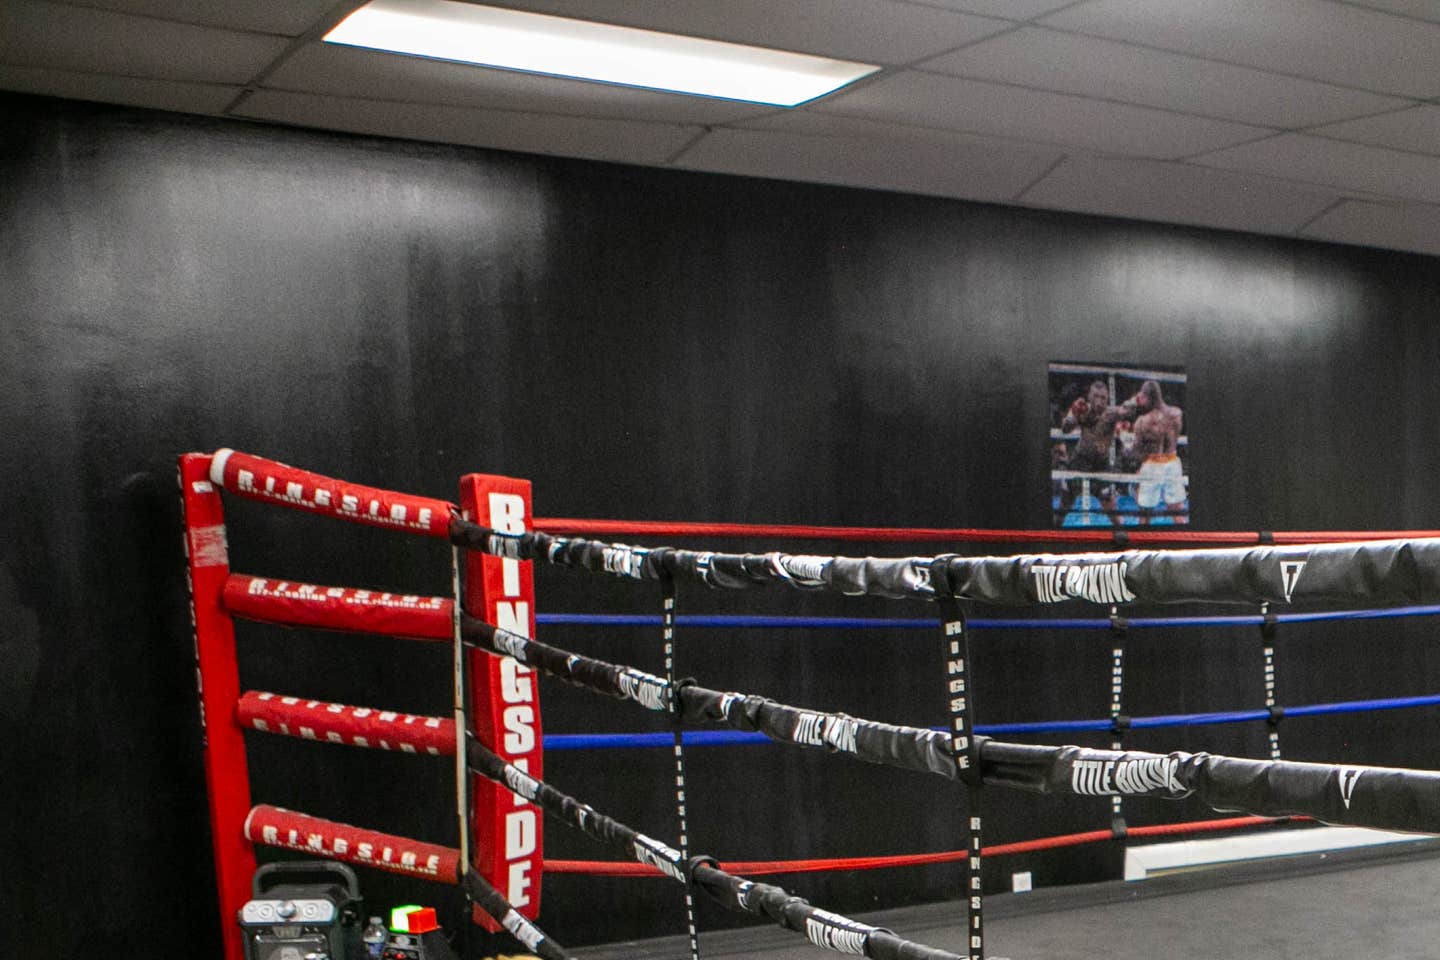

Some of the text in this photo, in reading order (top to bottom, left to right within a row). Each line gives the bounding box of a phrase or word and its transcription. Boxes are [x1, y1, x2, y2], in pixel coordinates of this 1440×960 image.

[238, 469, 432, 525] RINGSIDE
[1031, 561, 1137, 604] TITLE BOXING
[945, 620, 971, 769] RINGSIDE
[1072, 758, 1116, 796] TITLE
[262, 824, 441, 870] RINGSIDE
